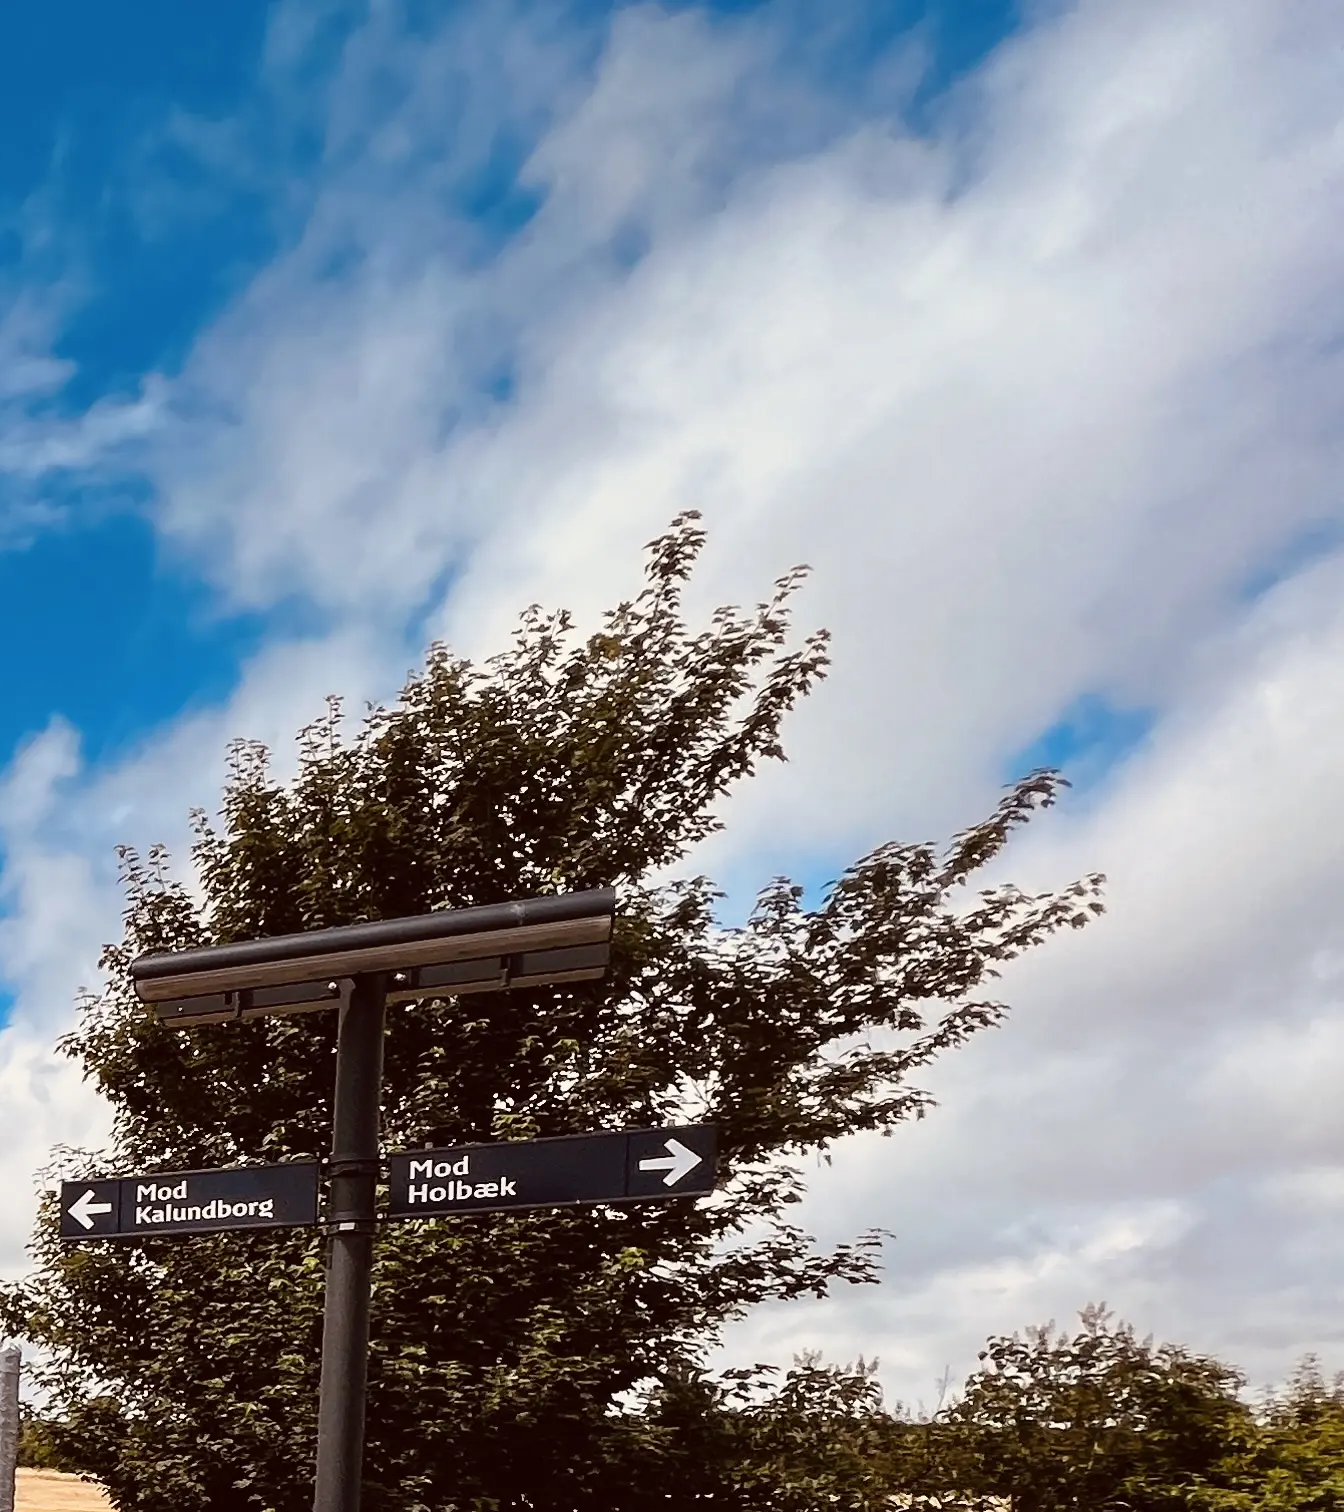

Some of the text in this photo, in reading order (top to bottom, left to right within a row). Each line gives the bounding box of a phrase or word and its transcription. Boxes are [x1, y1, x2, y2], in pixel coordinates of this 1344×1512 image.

[409, 1155, 469, 1180] Mod
[136, 1180, 188, 1202] Mod
[408, 1176, 517, 1204] Holbæk
[135, 1199, 274, 1224] Kalundborg
